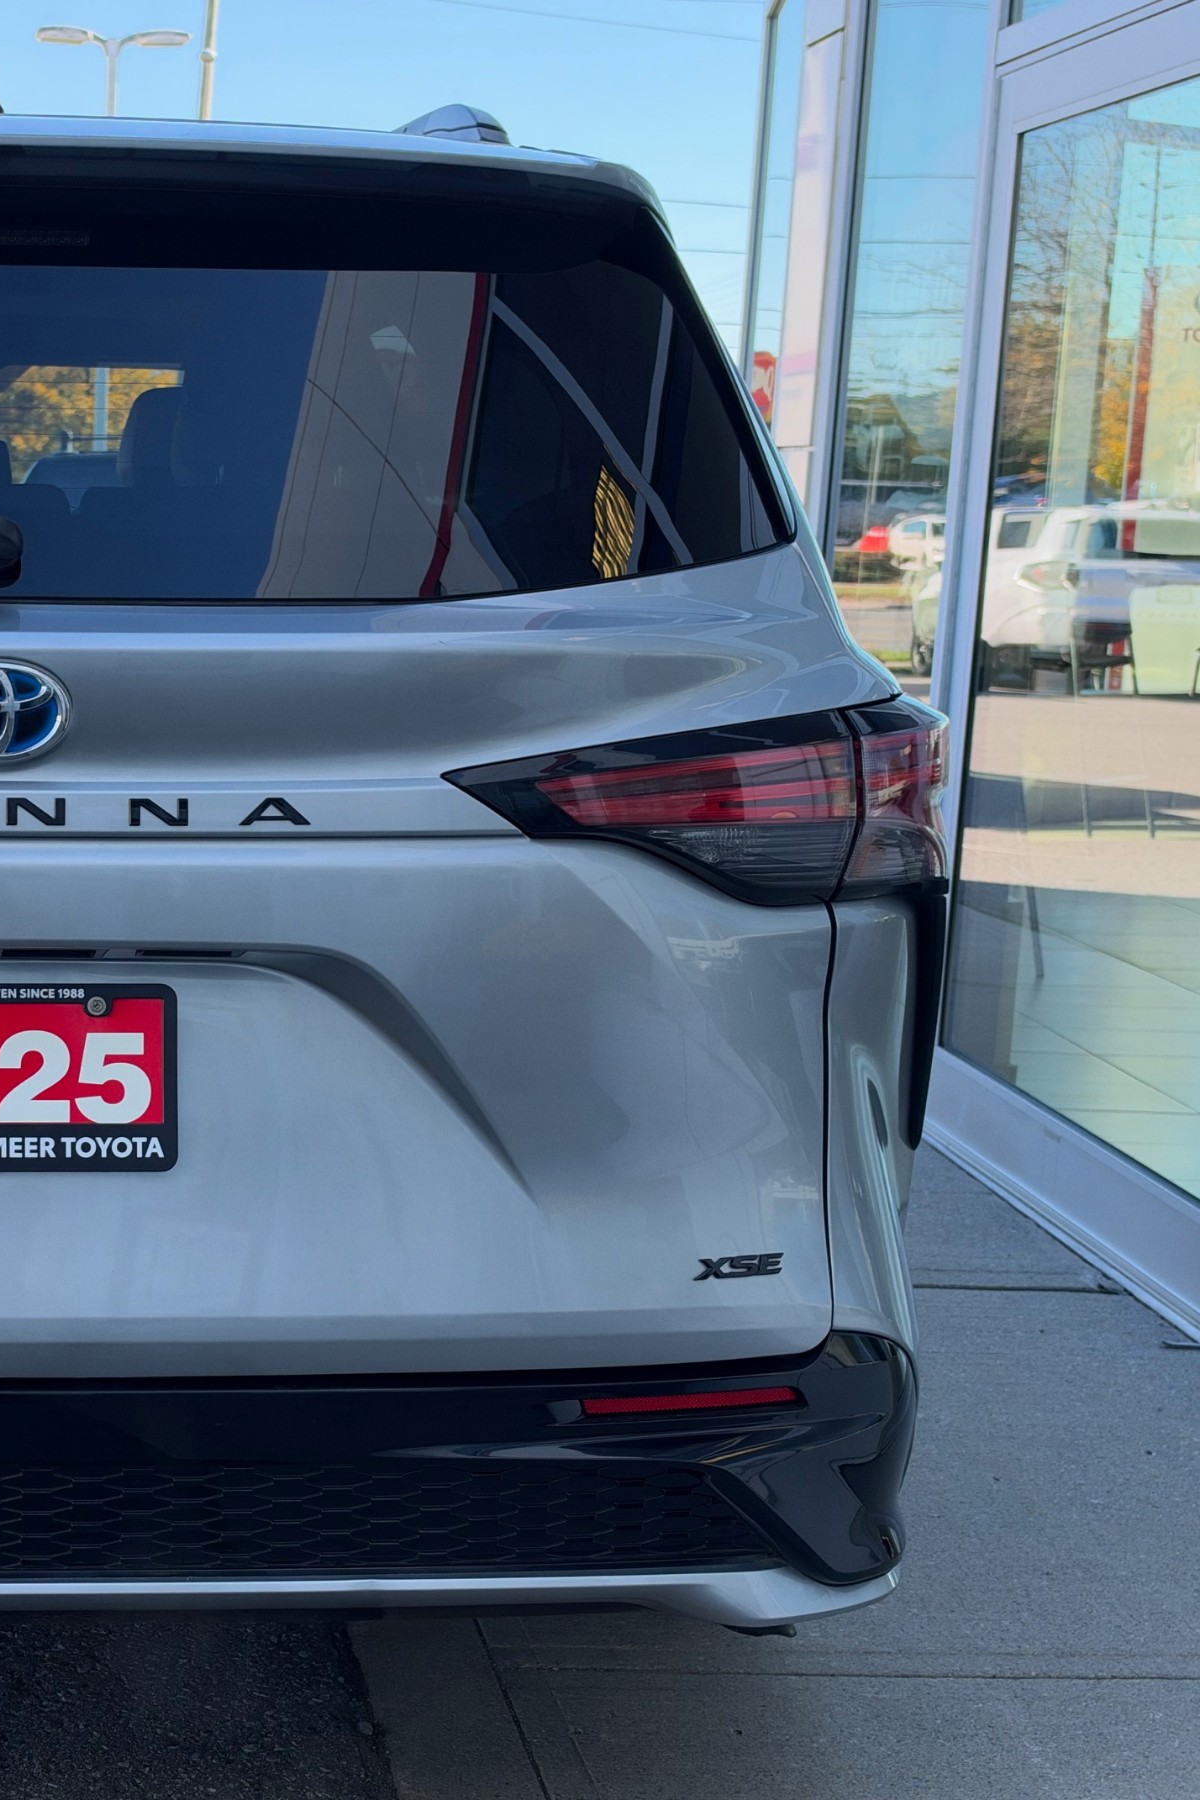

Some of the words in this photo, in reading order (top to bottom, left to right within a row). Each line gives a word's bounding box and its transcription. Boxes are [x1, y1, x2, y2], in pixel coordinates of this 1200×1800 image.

[19, 987, 55, 999] SINCE
[57, 987, 85, 999] 1988
[61, 1136, 165, 1159] TOYOTA
[692, 1252, 784, 1281] XSE
